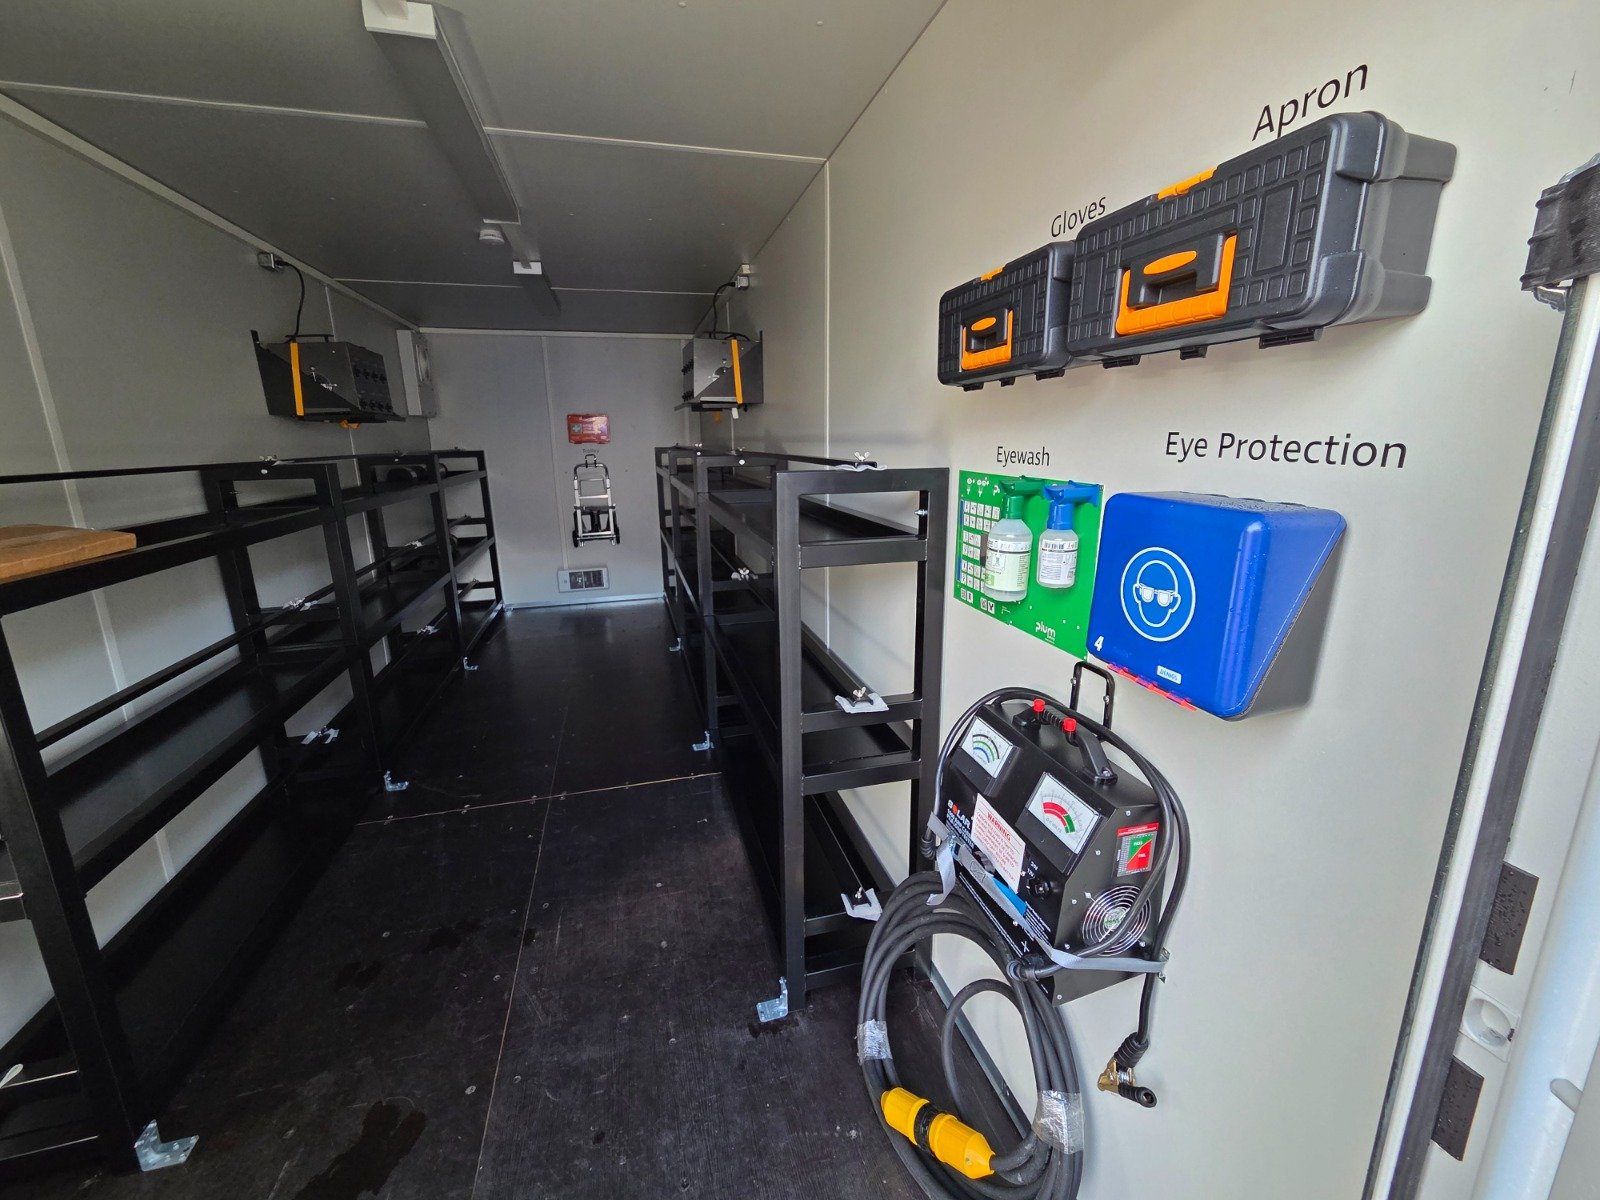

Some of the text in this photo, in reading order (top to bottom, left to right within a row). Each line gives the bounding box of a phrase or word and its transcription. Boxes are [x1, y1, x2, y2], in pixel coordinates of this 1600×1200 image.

[1252, 64, 1367, 141] Apron
[1051, 196, 1107, 238] Gloves
[996, 446, 1051, 467] Eyewash
[1165, 431, 1407, 469] Eye Protection
[1035, 621, 1056, 638] plum
[1094, 635, 1105, 652] 4
[986, 810, 1012, 842] WARNING
